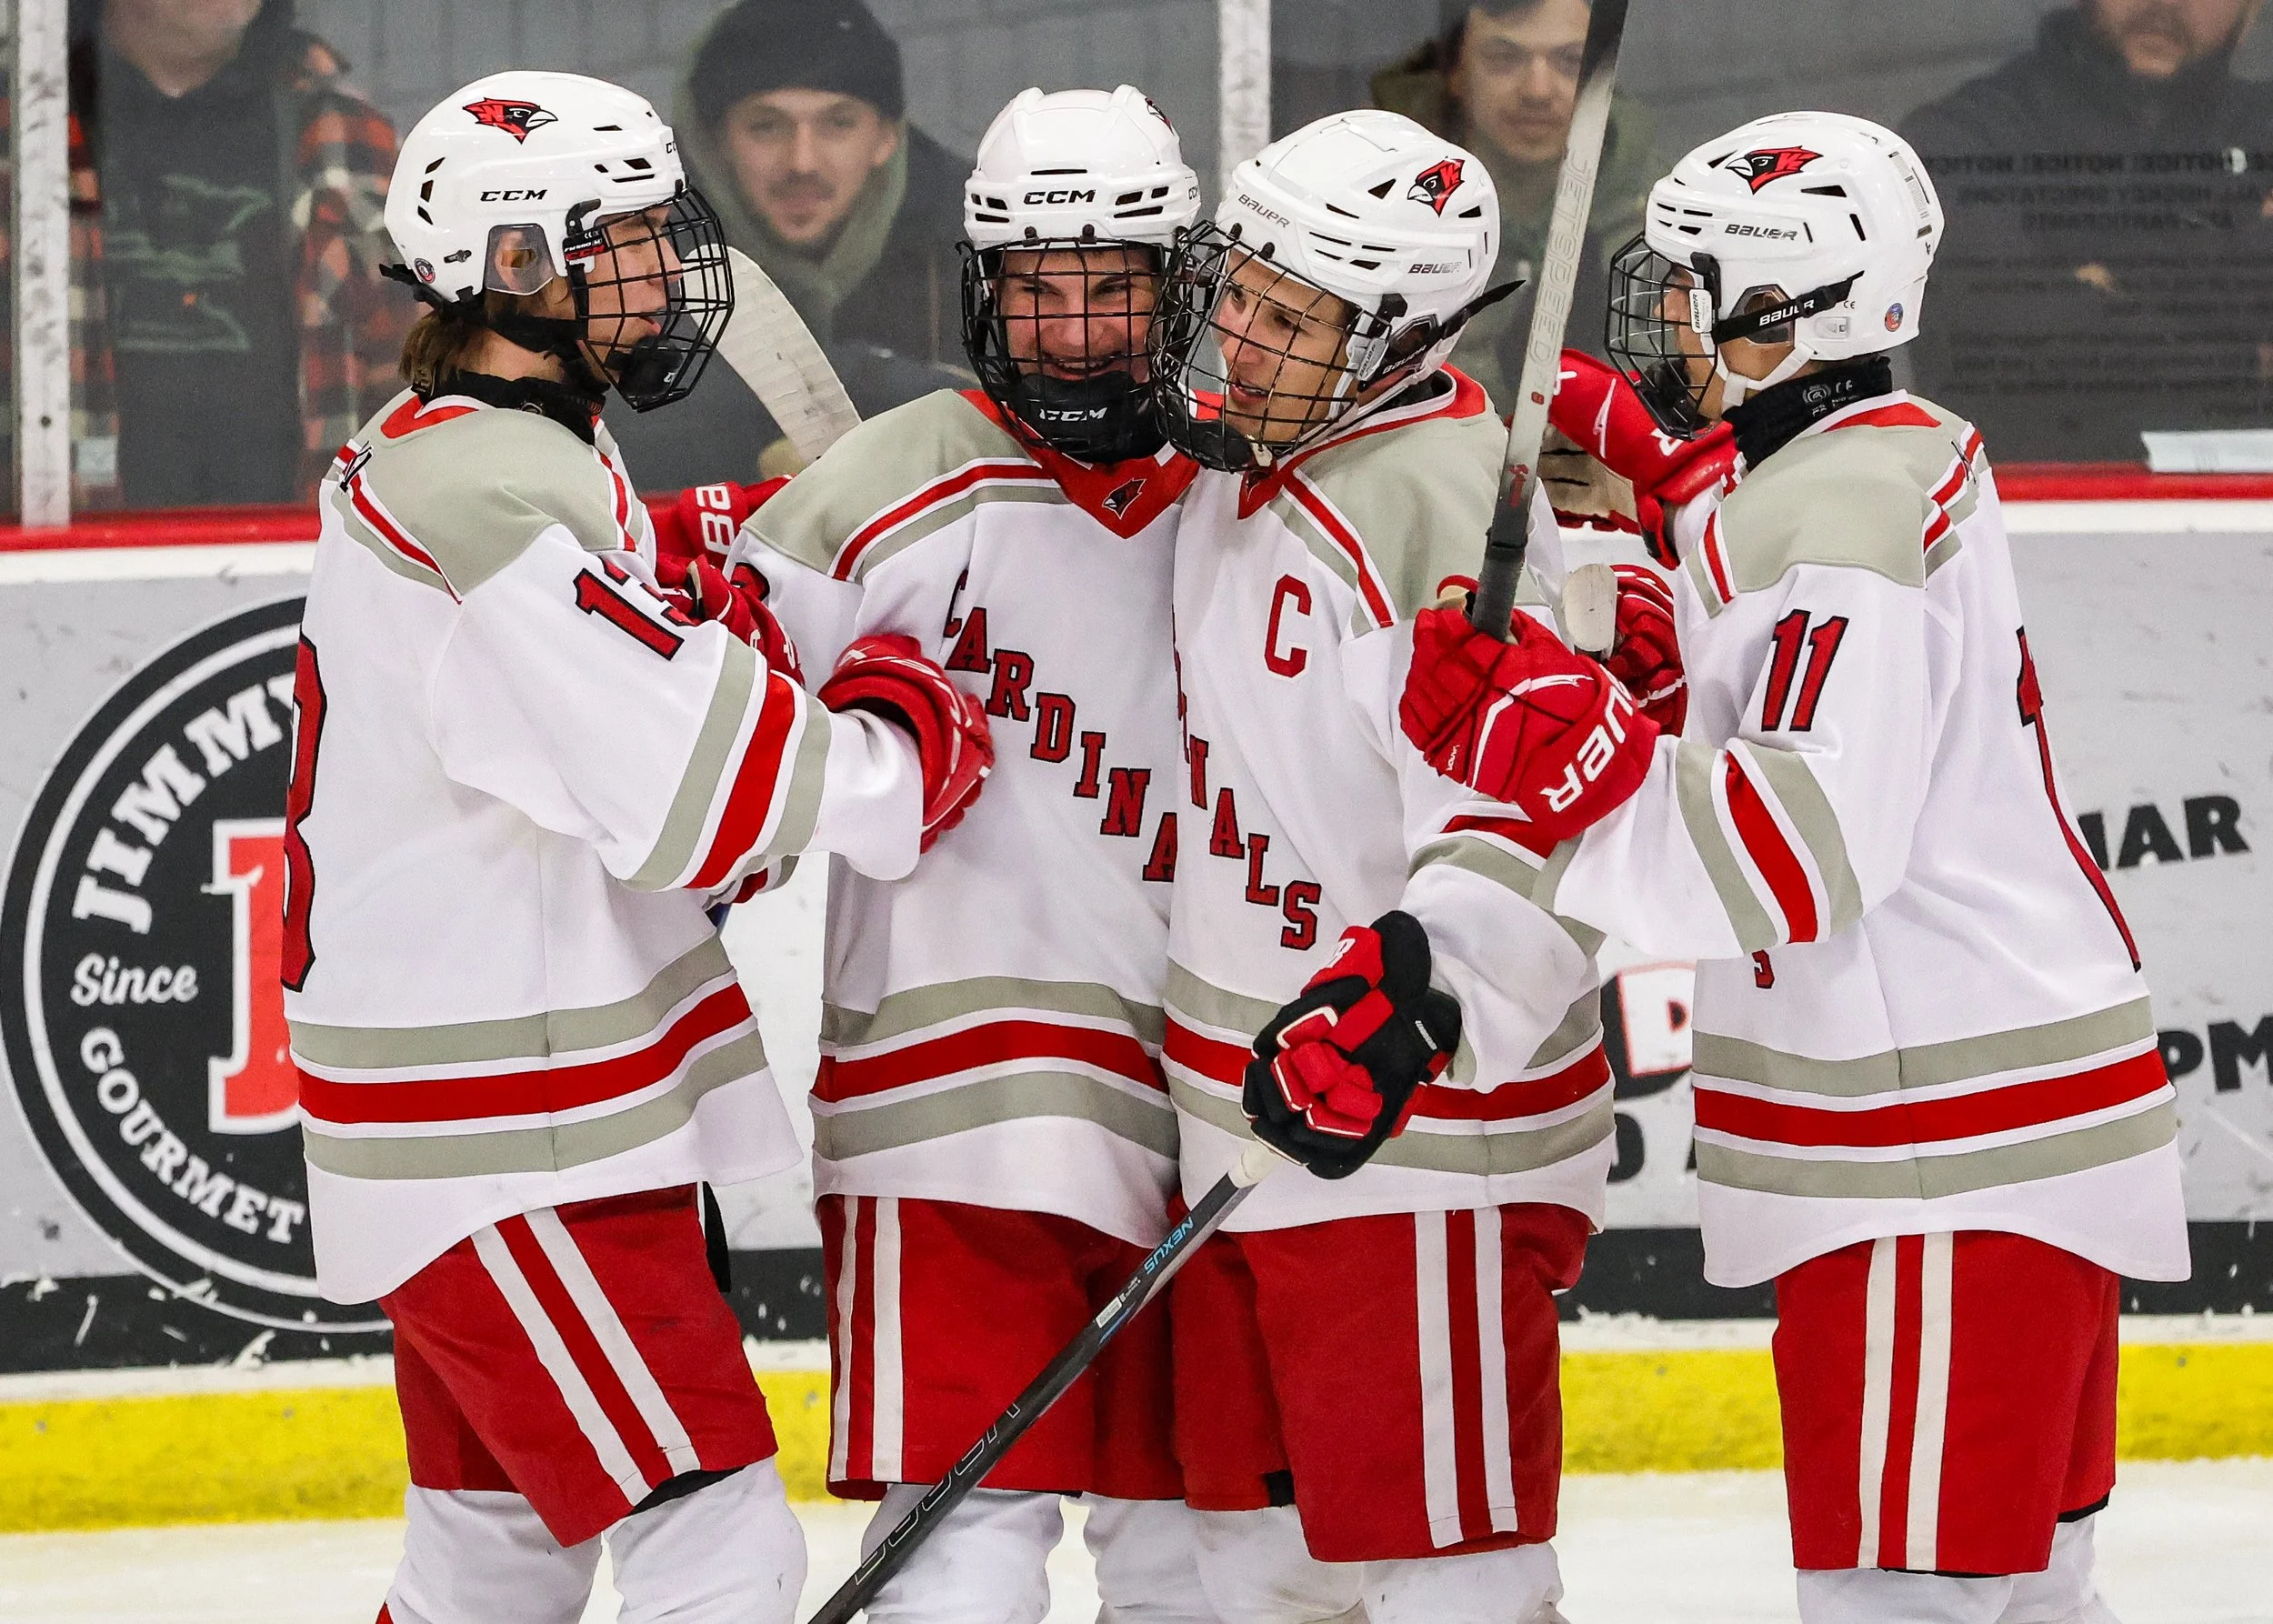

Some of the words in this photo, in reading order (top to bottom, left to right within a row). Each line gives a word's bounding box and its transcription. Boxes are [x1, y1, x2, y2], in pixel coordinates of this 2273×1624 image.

[480, 189, 548, 202] CCM
[1023, 189, 1096, 205] CCM
[1527, 150, 1590, 364] JETSPEED
[1725, 224, 1797, 241] BAUER
[1039, 406, 1108, 422] CCM
[1264, 574, 1312, 678] C
[1761, 608, 1849, 733] 11
[70, 952, 199, 1007] Since
[80, 1026, 304, 1245] GOURMET
[1144, 1216, 1194, 1275] NEXUS
